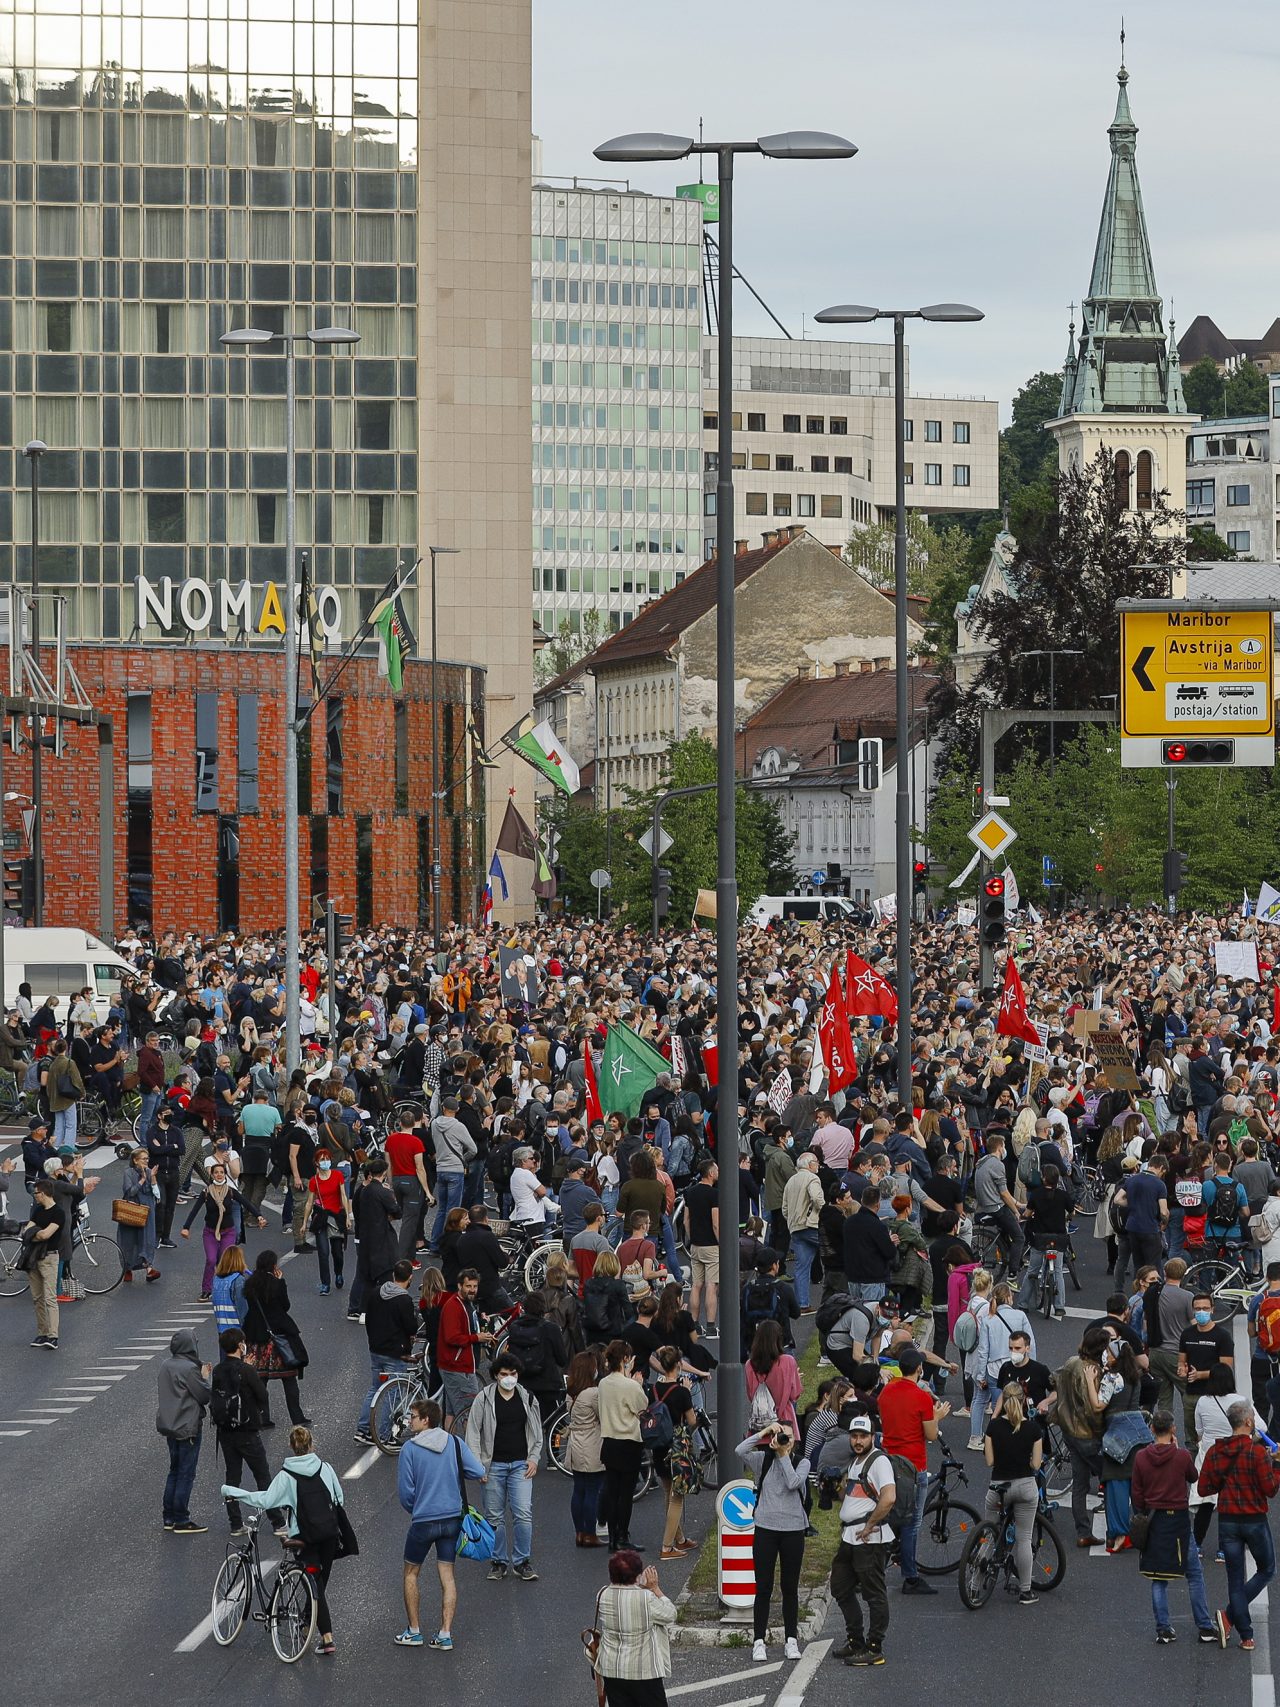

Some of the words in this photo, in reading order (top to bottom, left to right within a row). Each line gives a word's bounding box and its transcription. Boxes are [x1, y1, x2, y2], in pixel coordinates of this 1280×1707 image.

[134, 575, 342, 638] NOMAO
[1167, 612, 1231, 627] Maribor
[1168, 639, 1233, 657] Avstrija
[1247, 641, 1254, 653] A
[1223, 659, 1263, 671] Maribor
[1174, 702, 1258, 718] postaja/station
